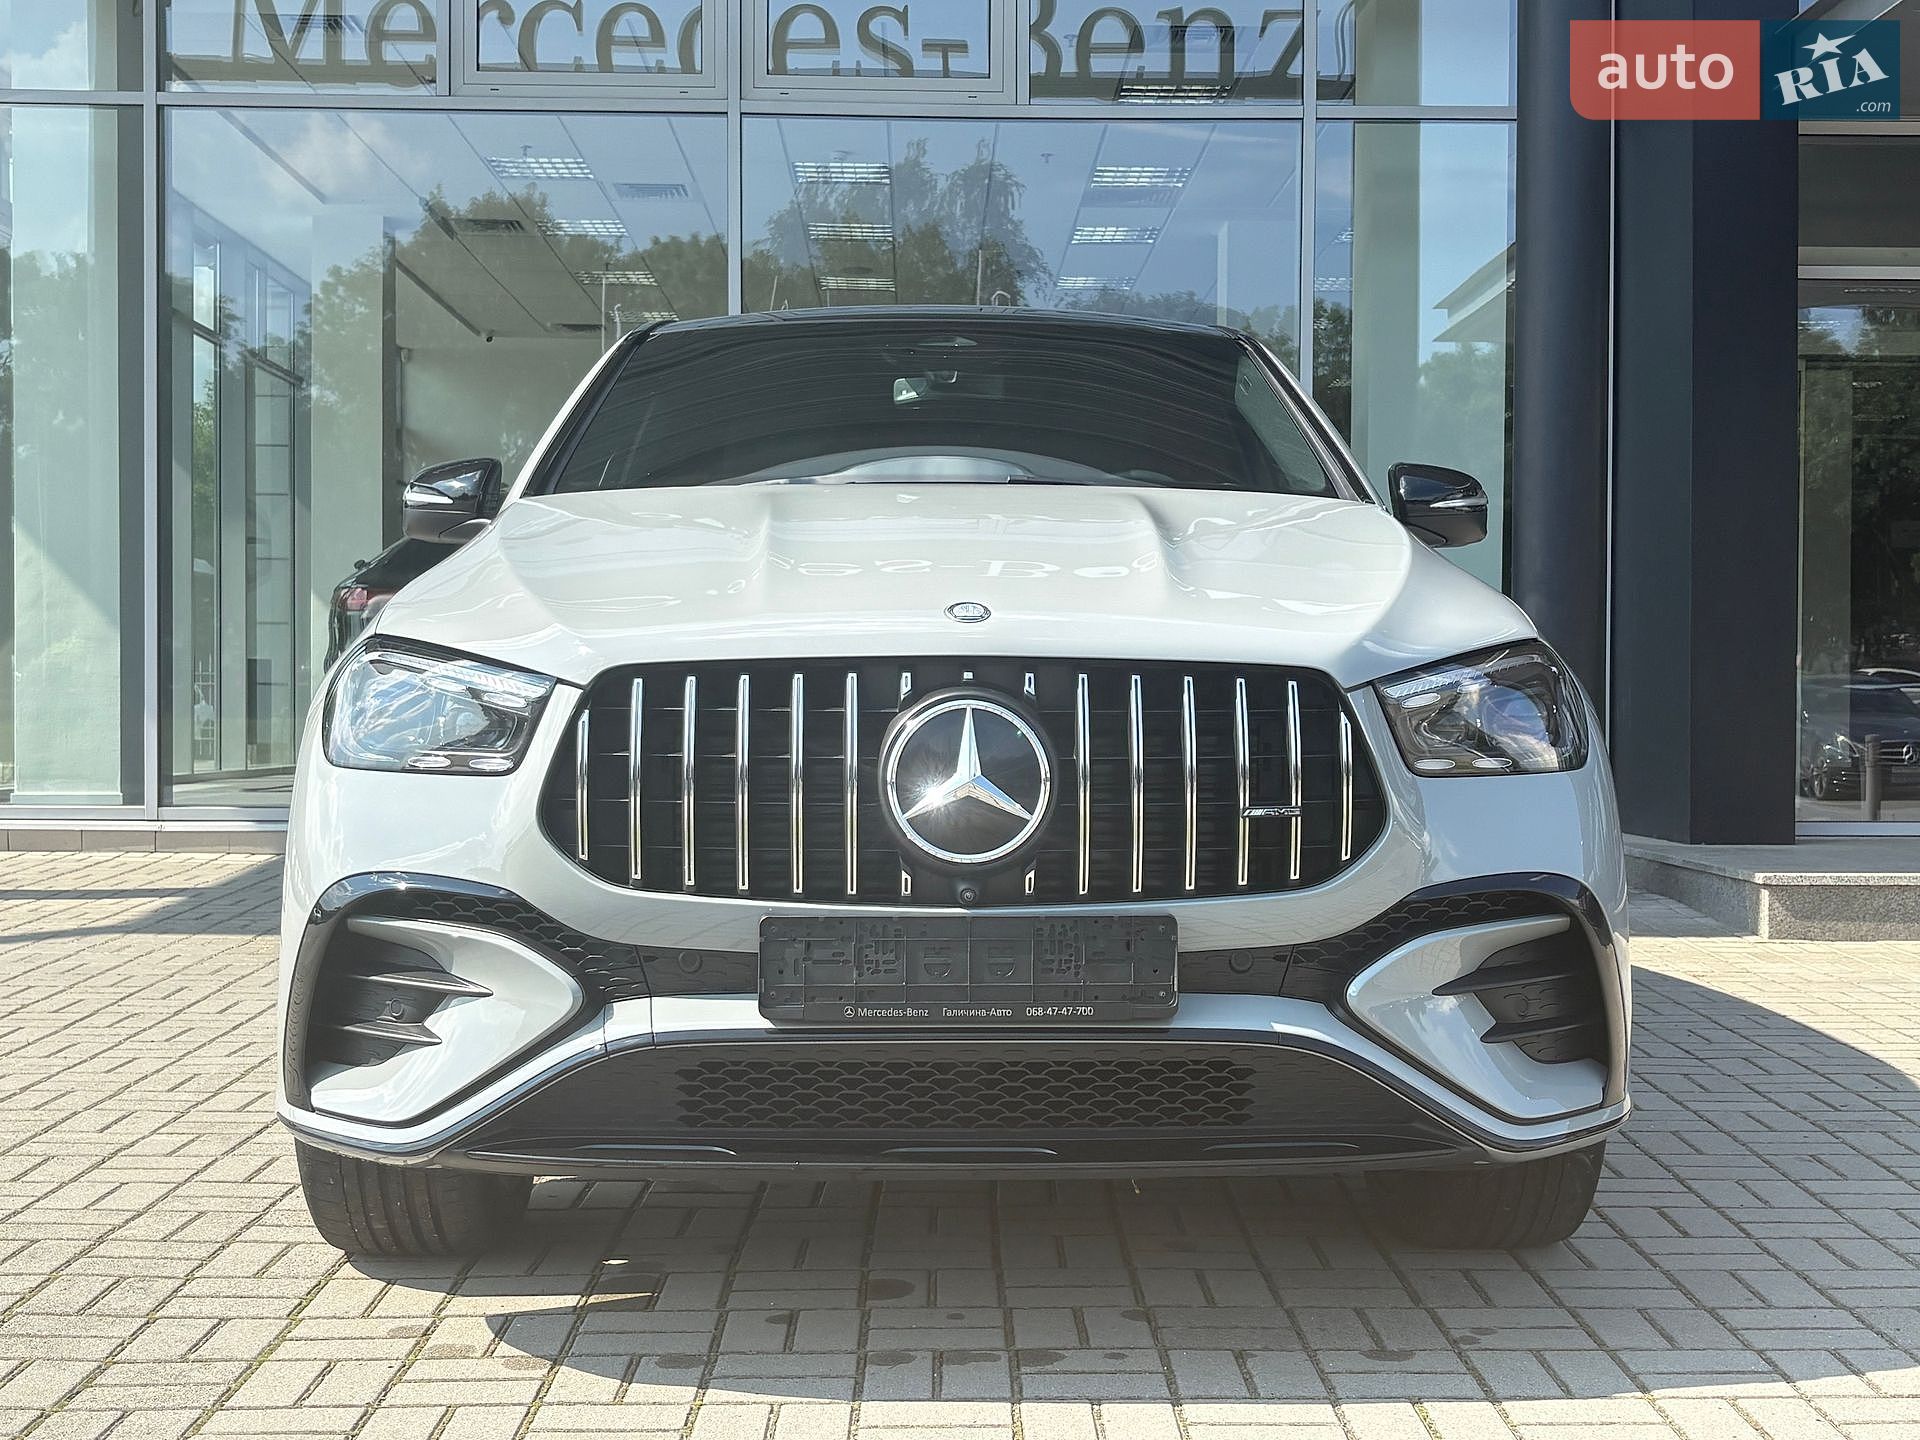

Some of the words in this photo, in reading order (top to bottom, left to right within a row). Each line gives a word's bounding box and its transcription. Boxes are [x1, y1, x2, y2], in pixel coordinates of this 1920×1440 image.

[858, 1007, 929, 1017] Mercedes-Benz
[942, 1007, 1013, 1017] Галичина-Авто
[1026, 1006, 1094, 1016] 068-47-47-700
